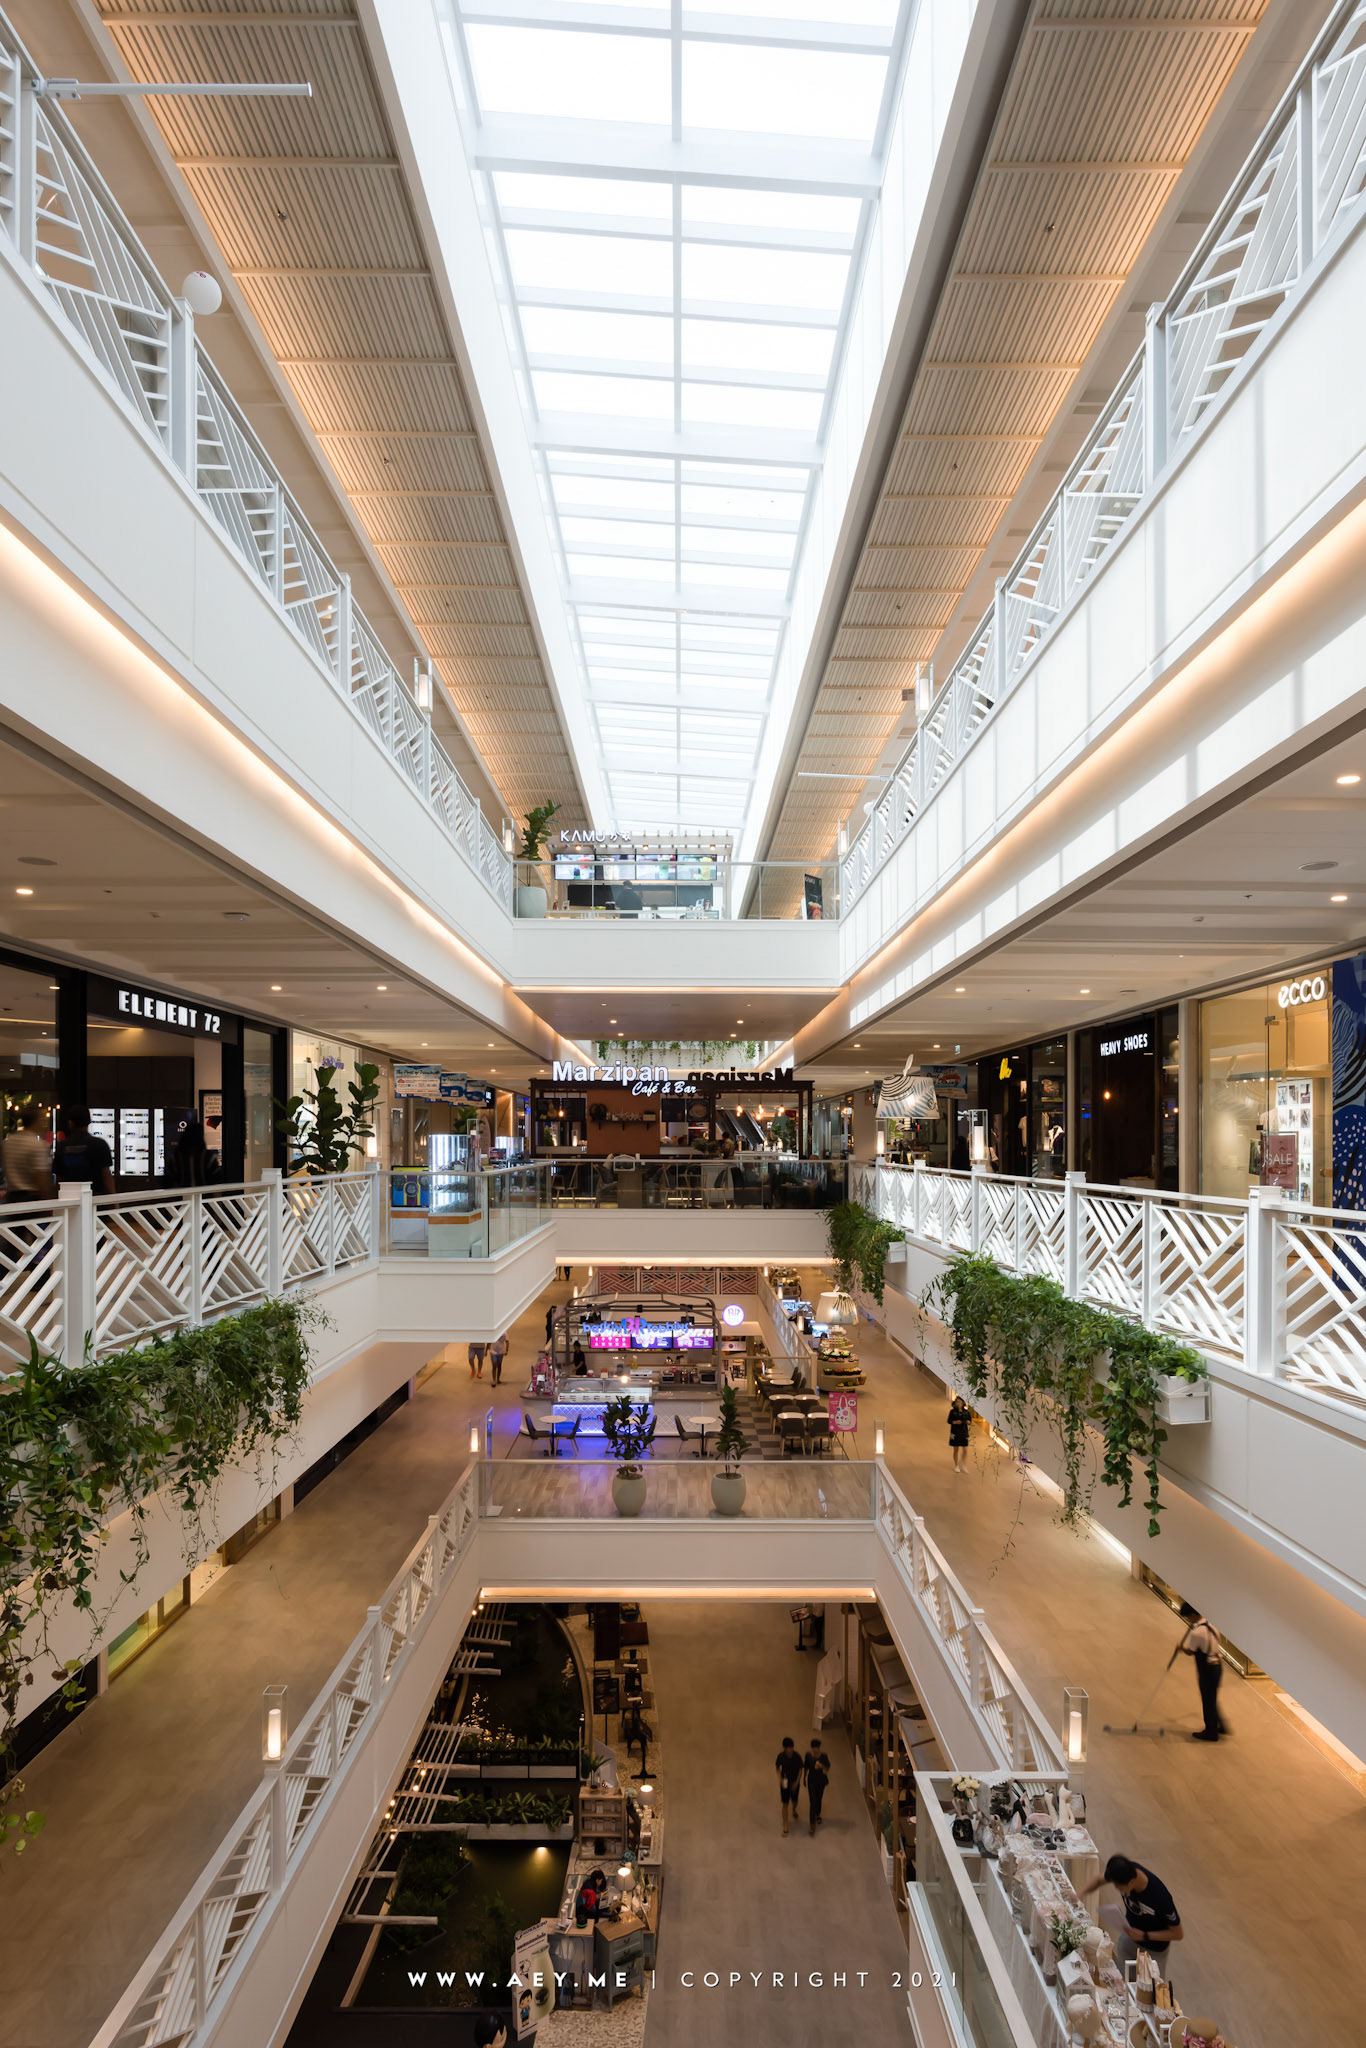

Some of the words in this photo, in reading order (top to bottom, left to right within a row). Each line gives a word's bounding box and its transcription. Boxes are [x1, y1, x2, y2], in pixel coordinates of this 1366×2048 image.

[560, 829, 605, 842] KAMU
[1278, 976, 1325, 1009] ecco
[118, 989, 198, 1029] ELEMENT
[204, 1012, 221, 1034] 72
[1100, 1039, 1121, 1057] HEAVY
[1123, 1033, 1149, 1051] SHOES
[552, 1060, 669, 1087] Marzipan
[631, 1081, 659, 1097] Café
[661, 1081, 671, 1093] &
[674, 1080, 697, 1094] Bar
[1268, 1153, 1293, 1165] SALE
[582, 1320, 621, 1333] baskin
[647, 1322, 689, 1334] robbins
